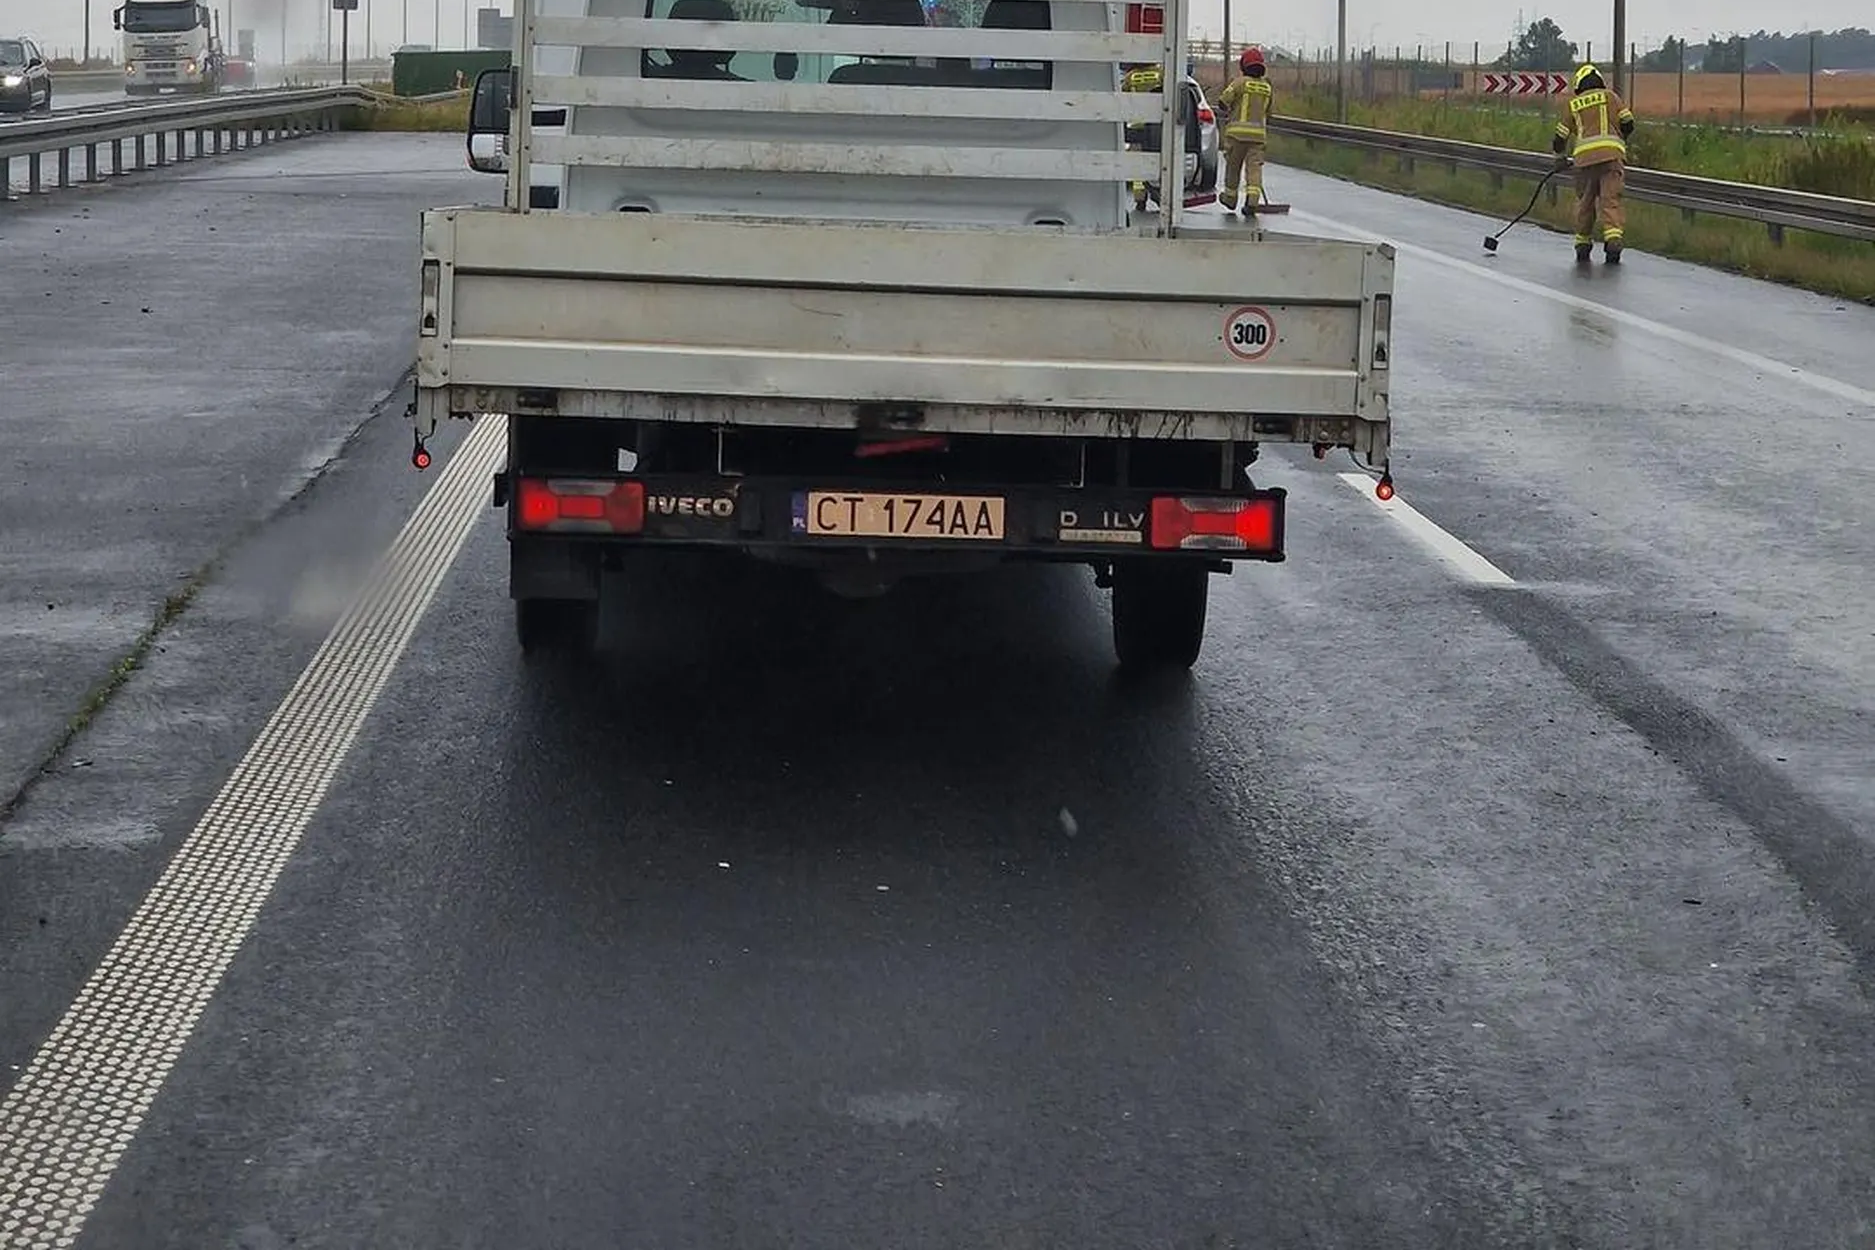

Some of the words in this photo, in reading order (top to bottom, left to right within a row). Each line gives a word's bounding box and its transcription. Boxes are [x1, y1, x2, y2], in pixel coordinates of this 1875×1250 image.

[1233, 323, 1267, 345] 300
[648, 496, 734, 516] IVECO
[817, 496, 864, 532] CT
[883, 498, 994, 536] 174AA
